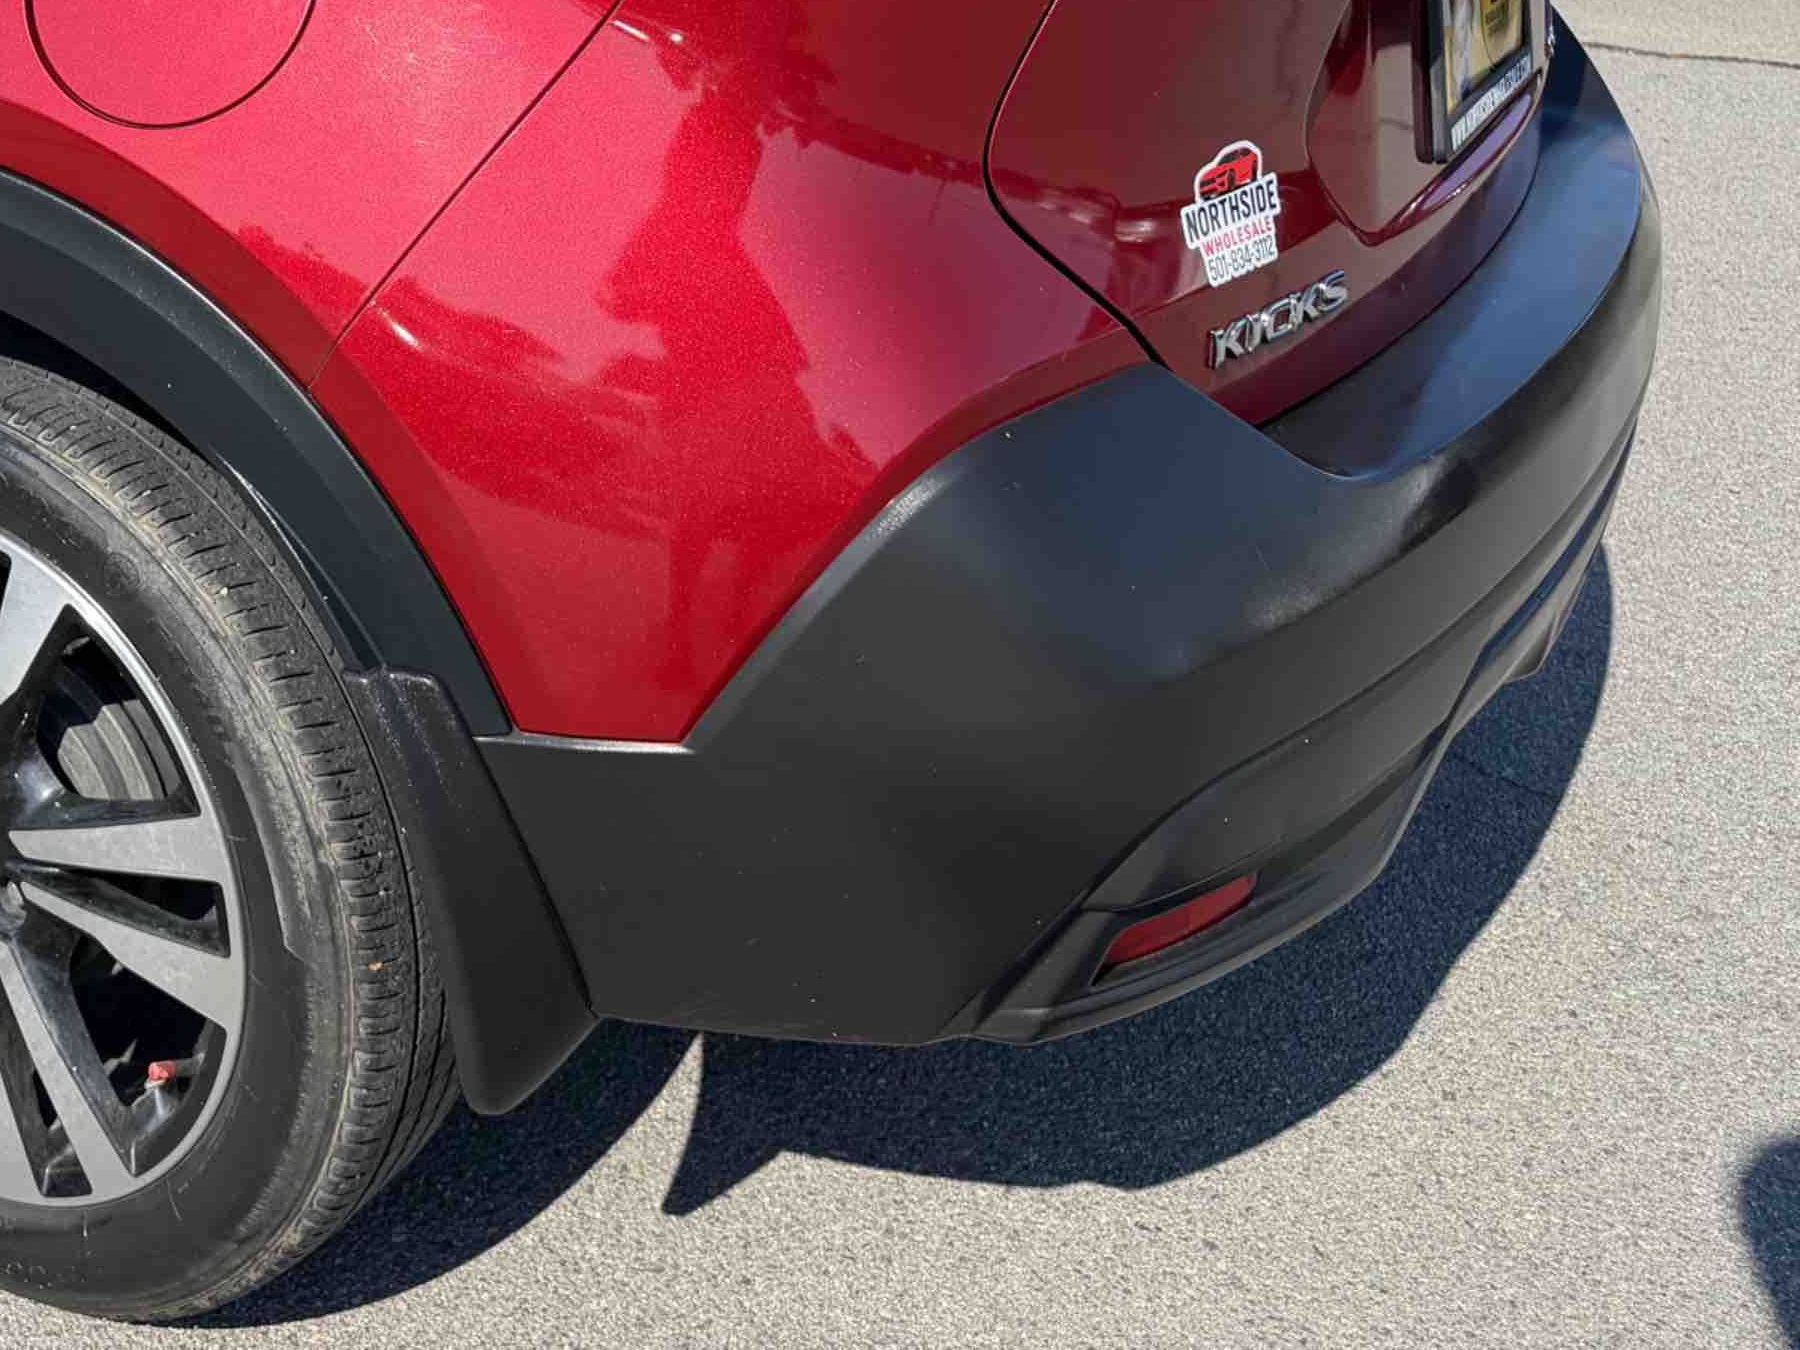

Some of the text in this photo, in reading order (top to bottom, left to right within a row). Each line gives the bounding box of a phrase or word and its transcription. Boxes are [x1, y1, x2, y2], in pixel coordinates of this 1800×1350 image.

[1185, 183, 1277, 243] NORTHSIDE
[1201, 217, 1272, 256] WHOLESALE
[1208, 269, 1348, 370] KICKS
